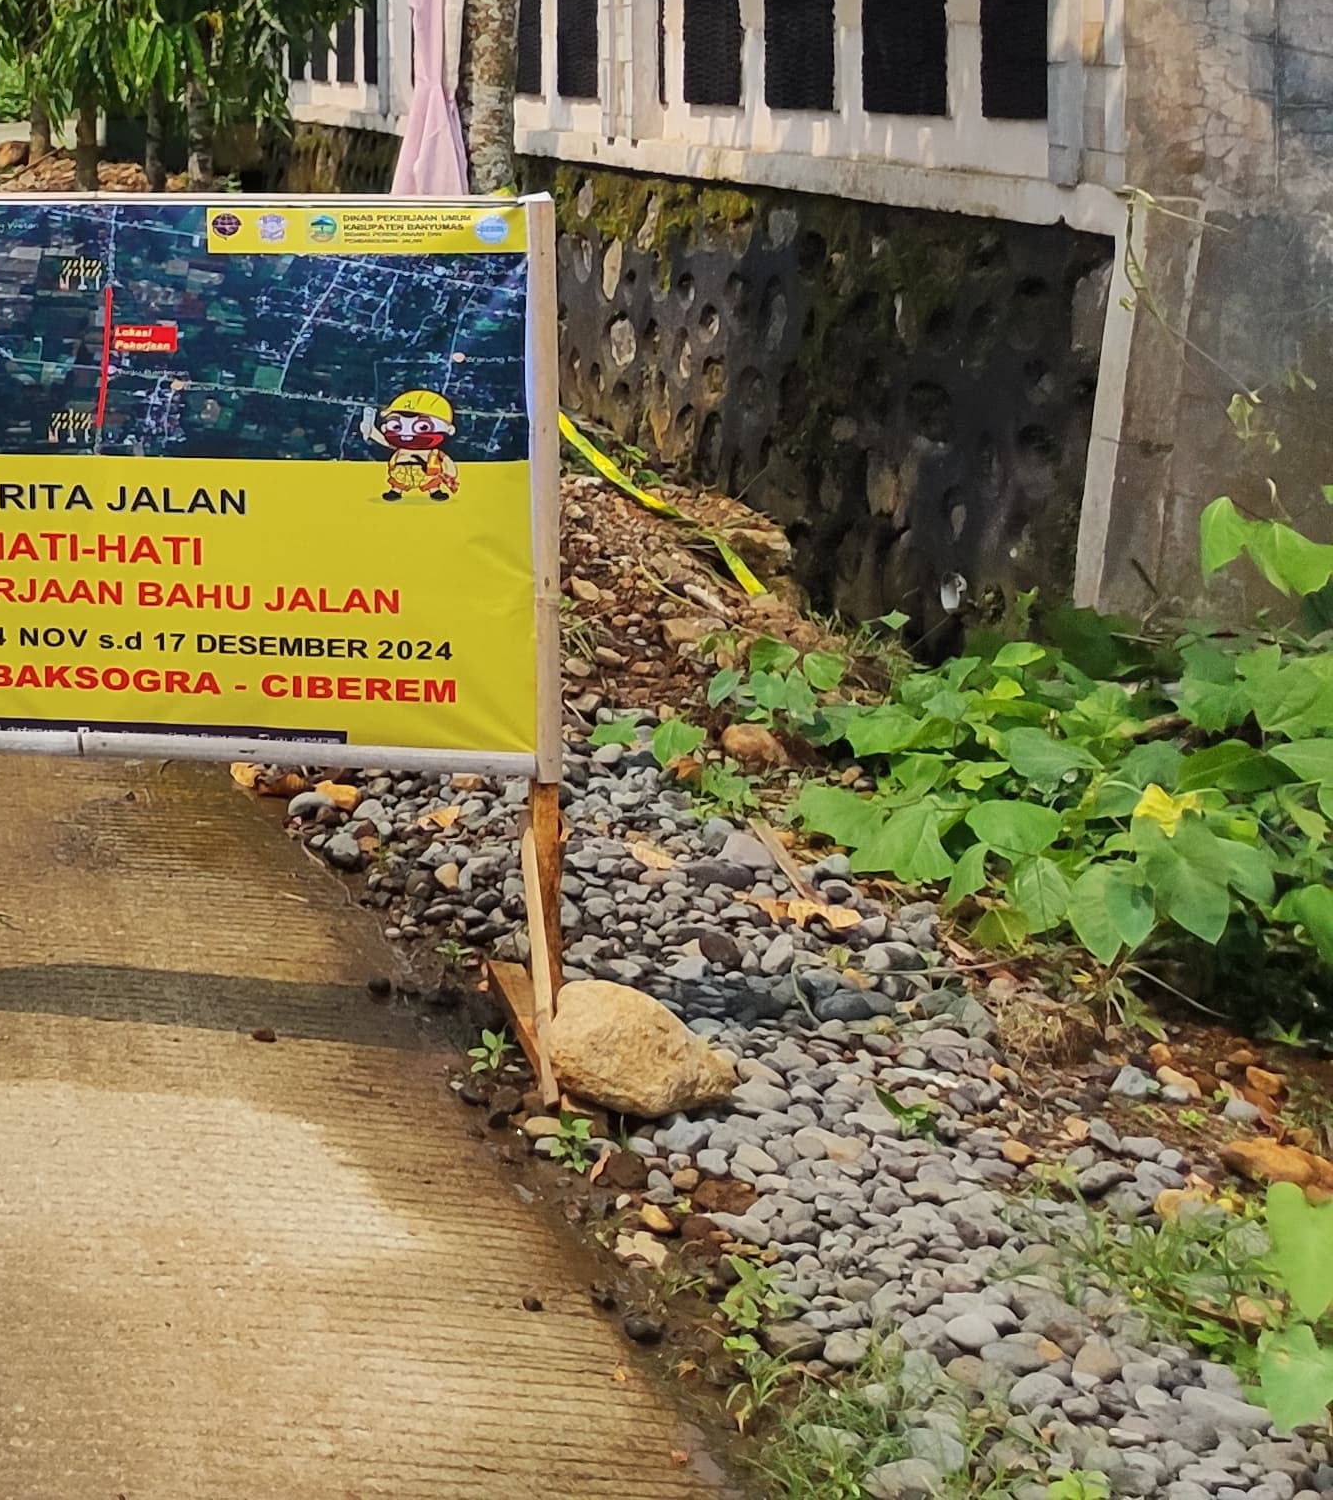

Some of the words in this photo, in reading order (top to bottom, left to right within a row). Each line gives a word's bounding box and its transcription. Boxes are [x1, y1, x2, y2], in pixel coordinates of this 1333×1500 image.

[342, 214, 374, 222] DINAS
[376, 214, 438, 222] PEKERJAAN
[440, 214, 471, 222] UMUM
[343, 223, 404, 231] KABUPATEN
[406, 223, 465, 231] BANYUMAS
[114, 326, 153, 338] Lokasi
[114, 339, 171, 352] Pekerjaan
[106, 486, 247, 516] JALAN
[137, 581, 251, 611] BAHU
[264, 586, 400, 615] JALAN
[19, 627, 89, 648] NOV
[98, 631, 142, 650] s.d
[153, 633, 186, 652] 17
[196, 634, 369, 659] DESEMBER
[377, 639, 453, 661] 2024
[261, 674, 457, 703] CIBEREM
